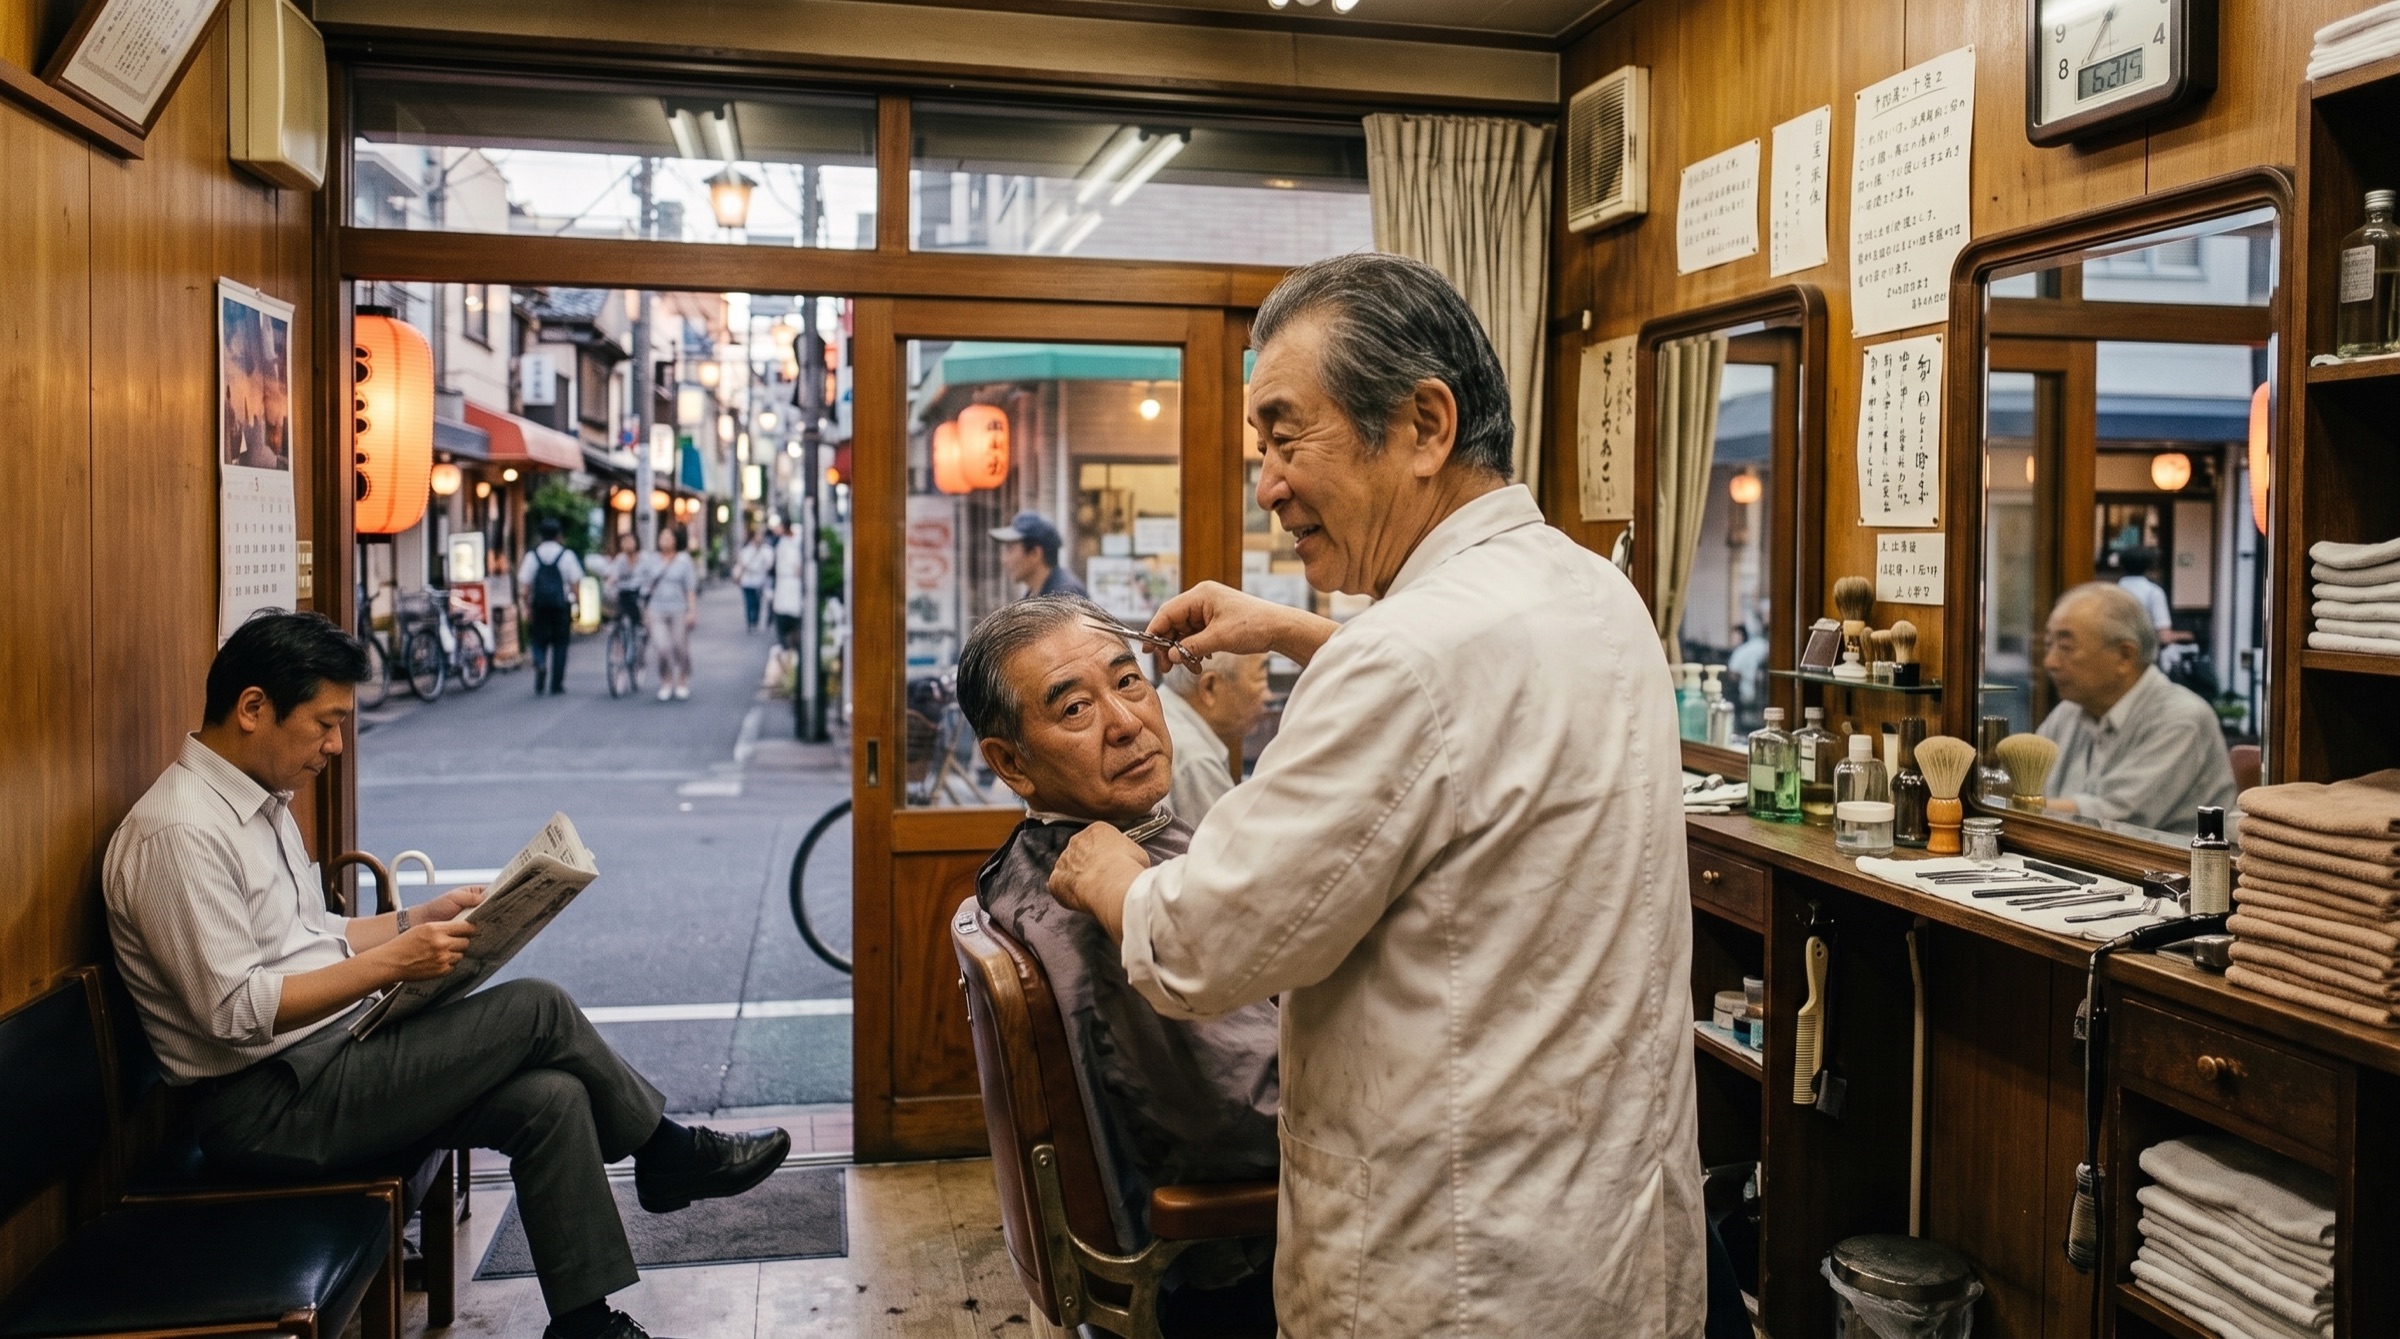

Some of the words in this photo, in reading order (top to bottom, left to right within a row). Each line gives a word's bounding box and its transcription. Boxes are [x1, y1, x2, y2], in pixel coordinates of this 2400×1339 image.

[2055, 24, 2066, 43] 9
[2153, 22, 2166, 45] 4
[2058, 58, 2069, 80] 8
